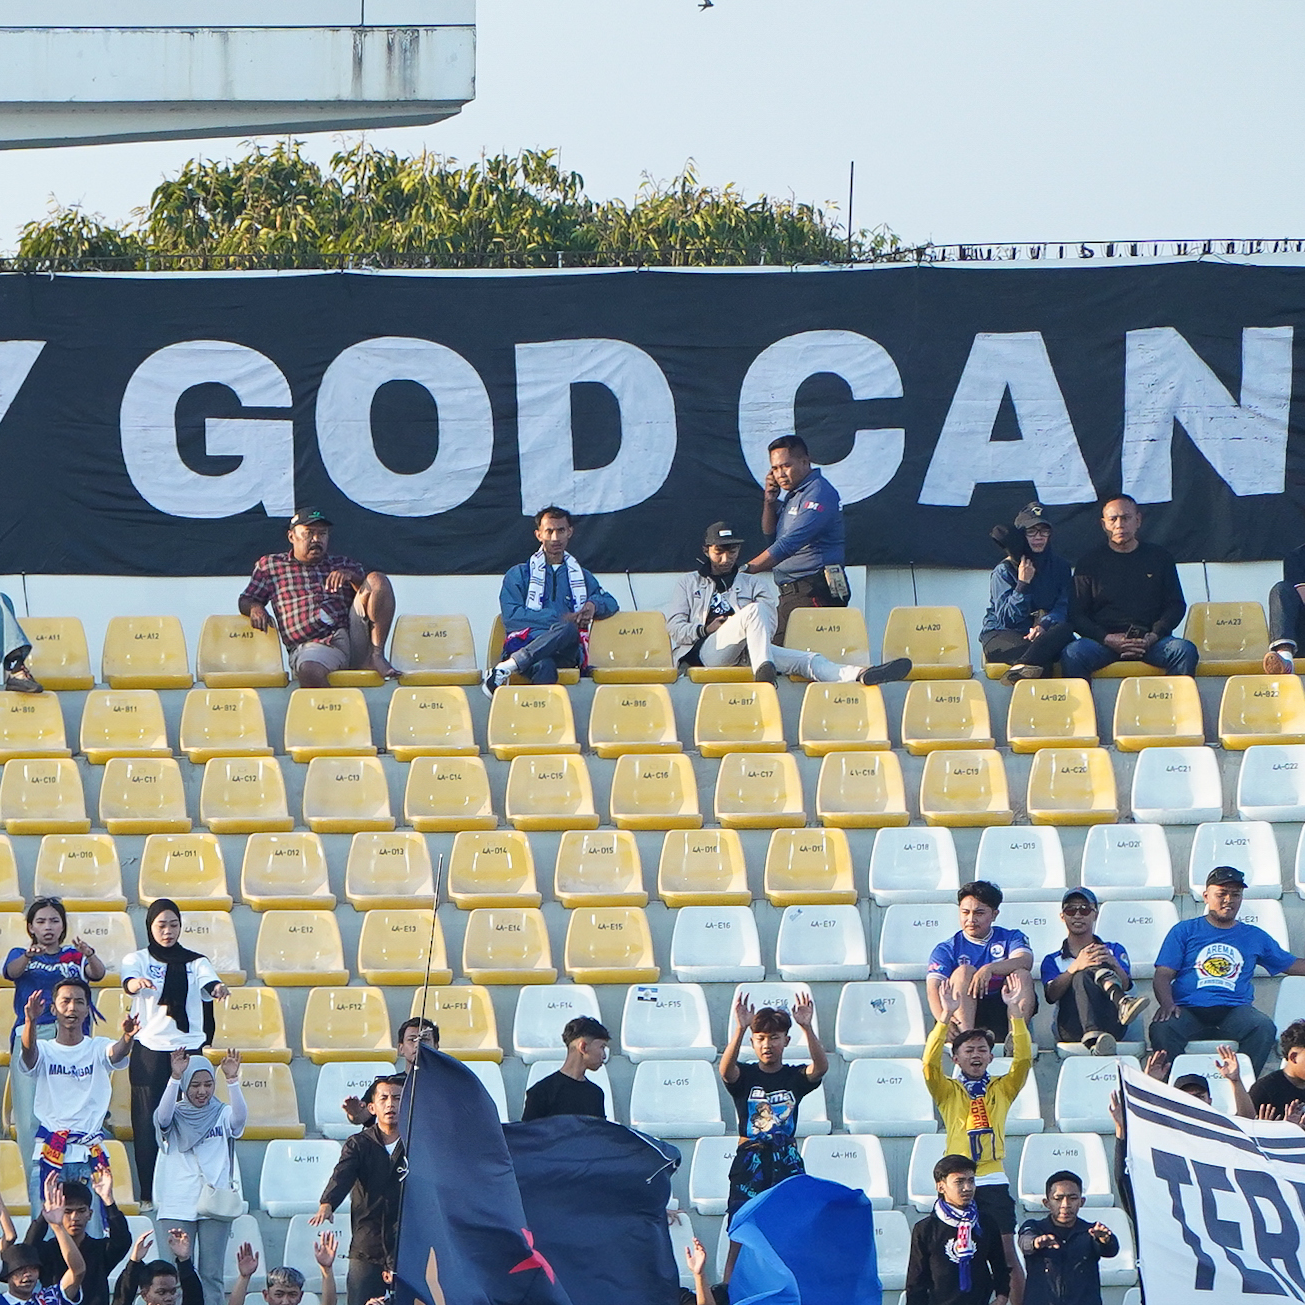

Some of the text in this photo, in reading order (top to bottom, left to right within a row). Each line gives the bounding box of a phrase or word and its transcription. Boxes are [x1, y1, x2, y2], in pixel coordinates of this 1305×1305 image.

[119, 335, 678, 519] GOD
[737, 325, 1295, 508] CAN
[1206, 944, 1235, 957] AREMA
